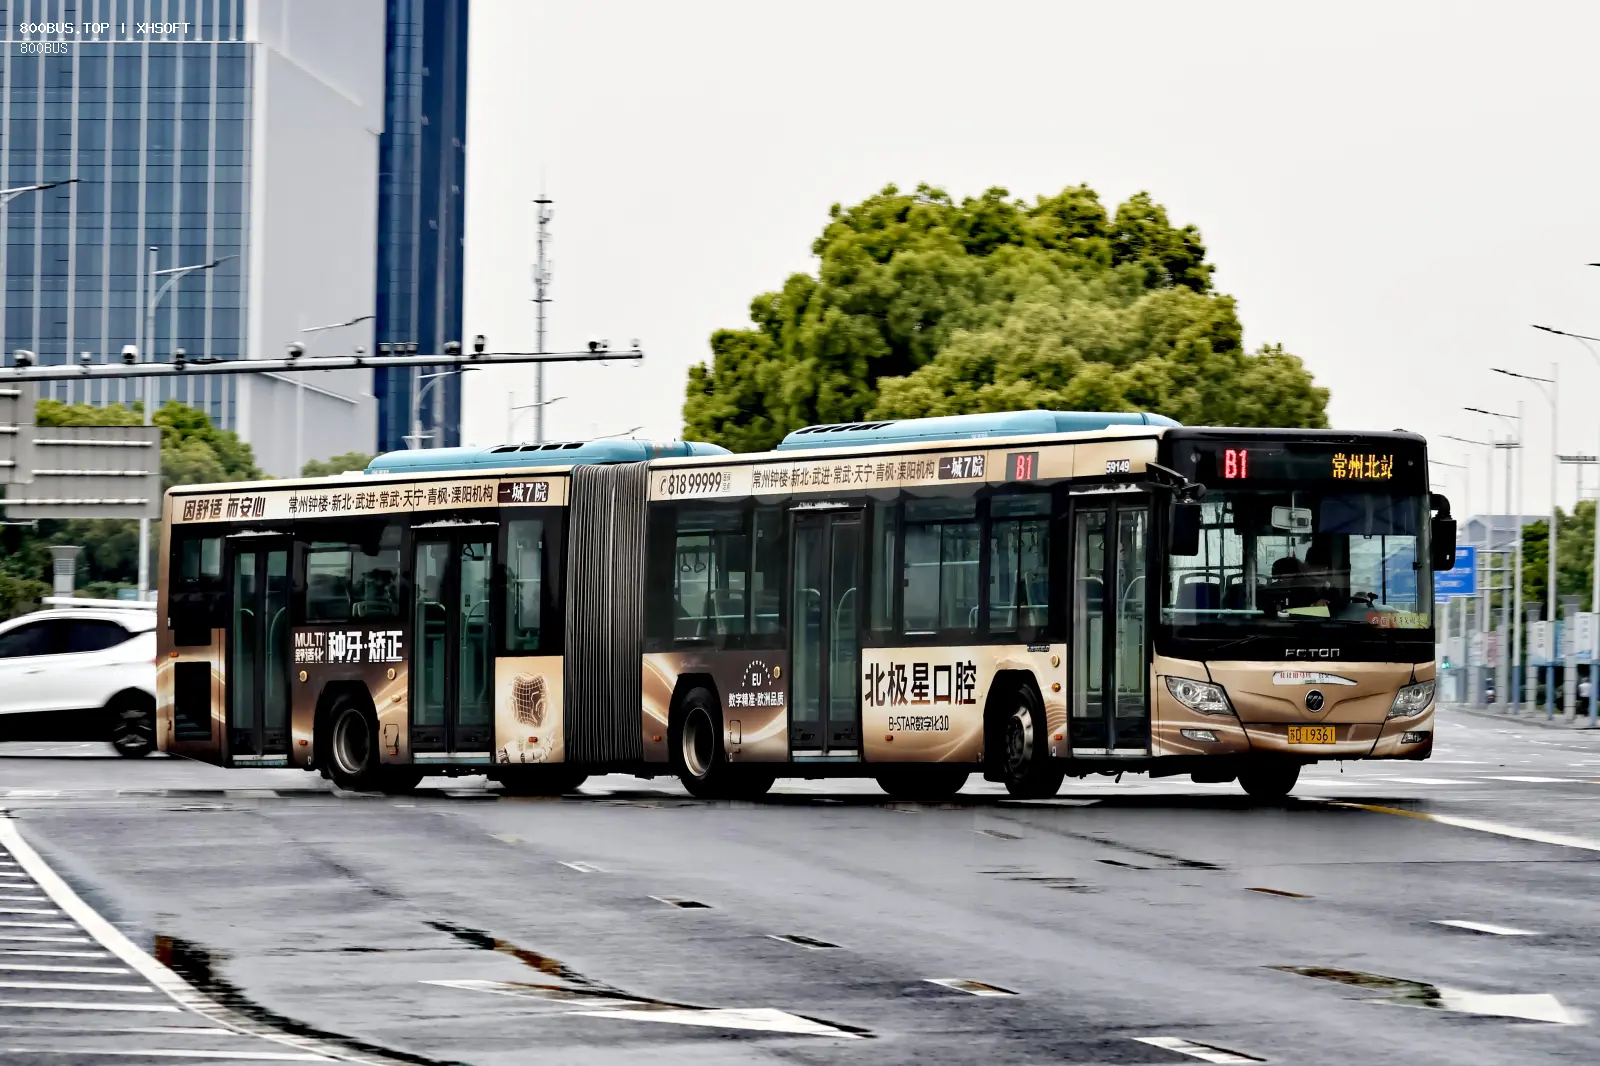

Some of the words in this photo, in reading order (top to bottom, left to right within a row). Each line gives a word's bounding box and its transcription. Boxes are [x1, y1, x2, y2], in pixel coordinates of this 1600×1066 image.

[939, 455, 985, 479] 一城7院
[1015, 454, 1033, 480] B1
[1106, 460, 1130, 474] 59149
[1224, 449, 1248, 479] B1
[1332, 452, 1393, 480] 常州北站
[498, 482, 548, 503] 一城7院
[295, 647, 325, 663] 舒适化
[752, 673, 762, 687] EU
[864, 660, 977, 708] 北极星口腔
